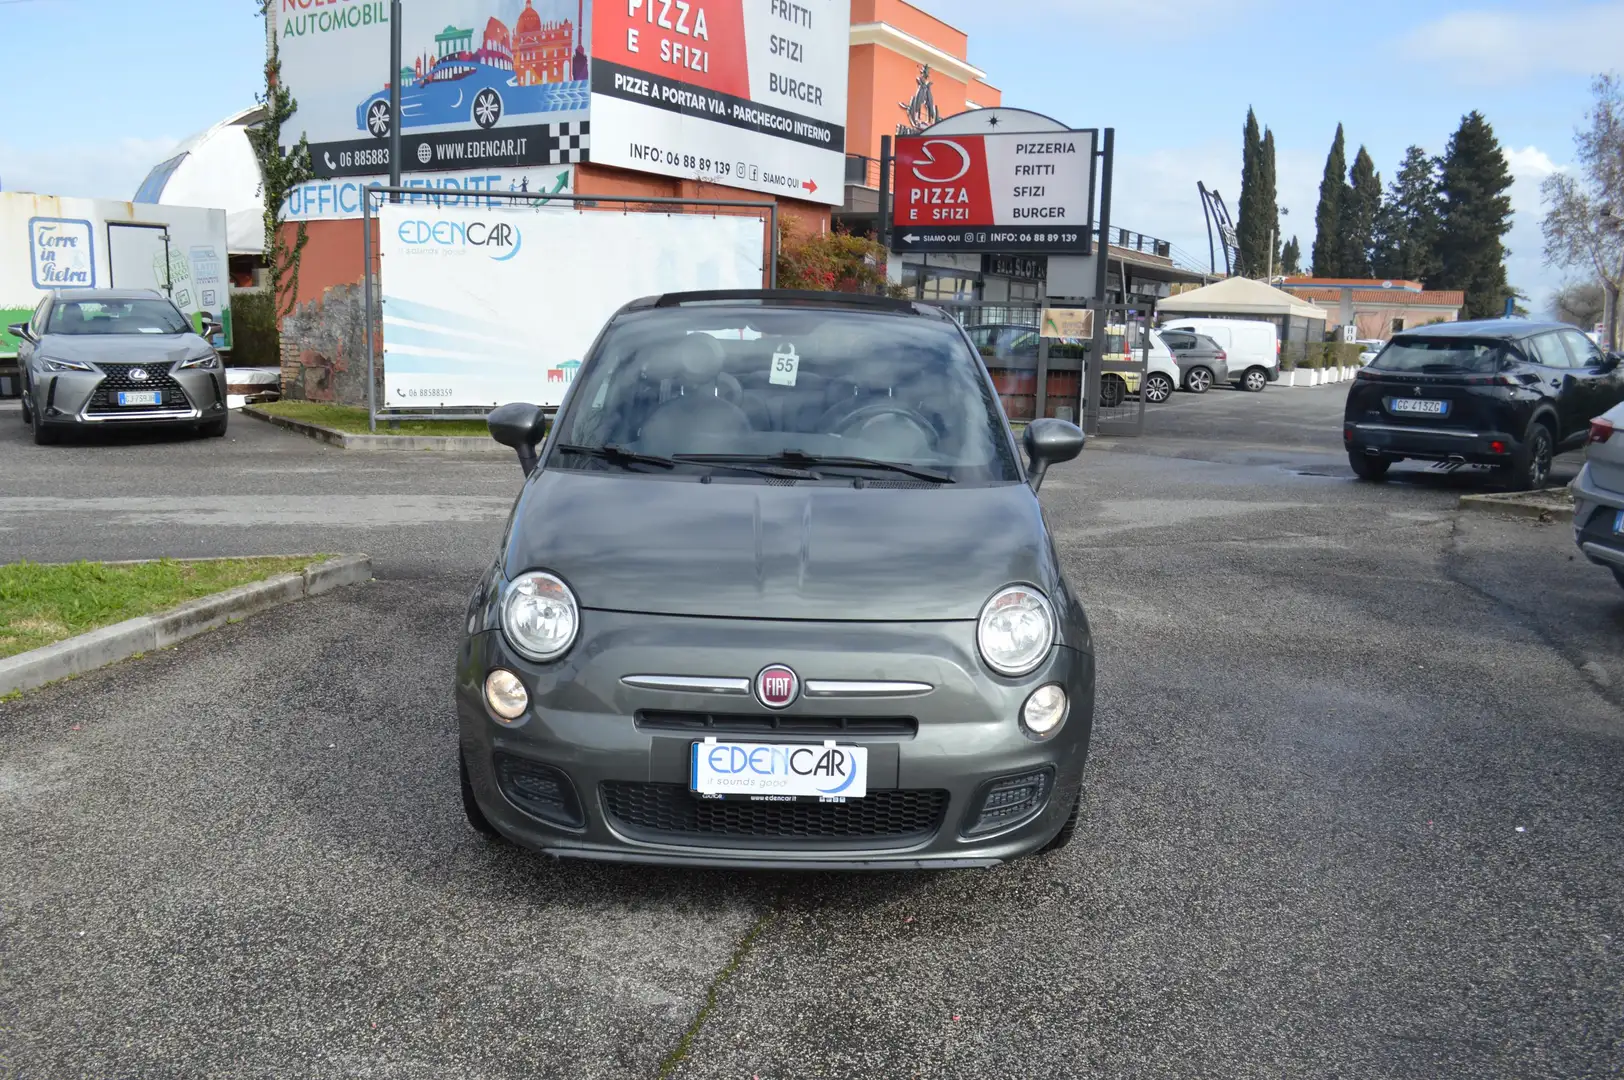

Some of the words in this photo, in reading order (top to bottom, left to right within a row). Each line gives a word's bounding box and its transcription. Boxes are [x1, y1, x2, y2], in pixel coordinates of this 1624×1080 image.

[283, 2, 388, 38] AUTOMOBIL
[771, 0, 811, 29] FRITTI
[627, 28, 639, 53] E
[660, 38, 708, 73] SFIZI
[770, 34, 802, 63] SFIZI
[770, 72, 822, 106] BURGER
[614, 73, 649, 97] PIZZE
[651, 83, 660, 99] A
[662, 86, 706, 111] PORTAR
[708, 98, 726, 116] VIA
[733, 104, 792, 133] PARCHEGGIO
[794, 121, 831, 143] INTERNO
[436, 138, 527, 160] WWW.EDENCAR.IT
[1016, 142, 1076, 154] PIZZERIA
[340, 151, 352, 167] 06
[630, 143, 663, 163] INFO:
[666, 151, 680, 166] 06
[683, 155, 696, 169] 88
[699, 157, 711, 171] 89
[715, 160, 731, 175] 139
[763, 172, 785, 186] SIAMO
[787, 177, 799, 188] QUI
[1015, 164, 1055, 176] FRITTI
[911, 187, 969, 204] PIZZA
[1013, 186, 1045, 197] SFIZI
[910, 208, 918, 220] E
[932, 208, 969, 220] SFIZI
[1013, 207, 1065, 218] BURGER
[38, 226, 78, 247] Torre
[398, 220, 513, 246] EDENCAR
[923, 234, 946, 242] SIAMO
[947, 234, 961, 243] QUI
[990, 232, 1017, 242] INFO:
[1020, 233, 1032, 242] 06
[1033, 233, 1045, 242] 88
[1047, 233, 1059, 242] 89
[1061, 233, 1078, 242] 139
[40, 248, 56, 261] in
[42, 262, 87, 282] Pietra
[1015, 257, 1037, 279] SLOT
[776, 358, 794, 372] 55
[408, 388, 418, 397] 06
[420, 388, 453, 397] 88588359
[766, 677, 790, 696] FIAT
[708, 745, 846, 776] EDENCAR
[716, 777, 756, 786] sounds
[759, 778, 788, 789] good
